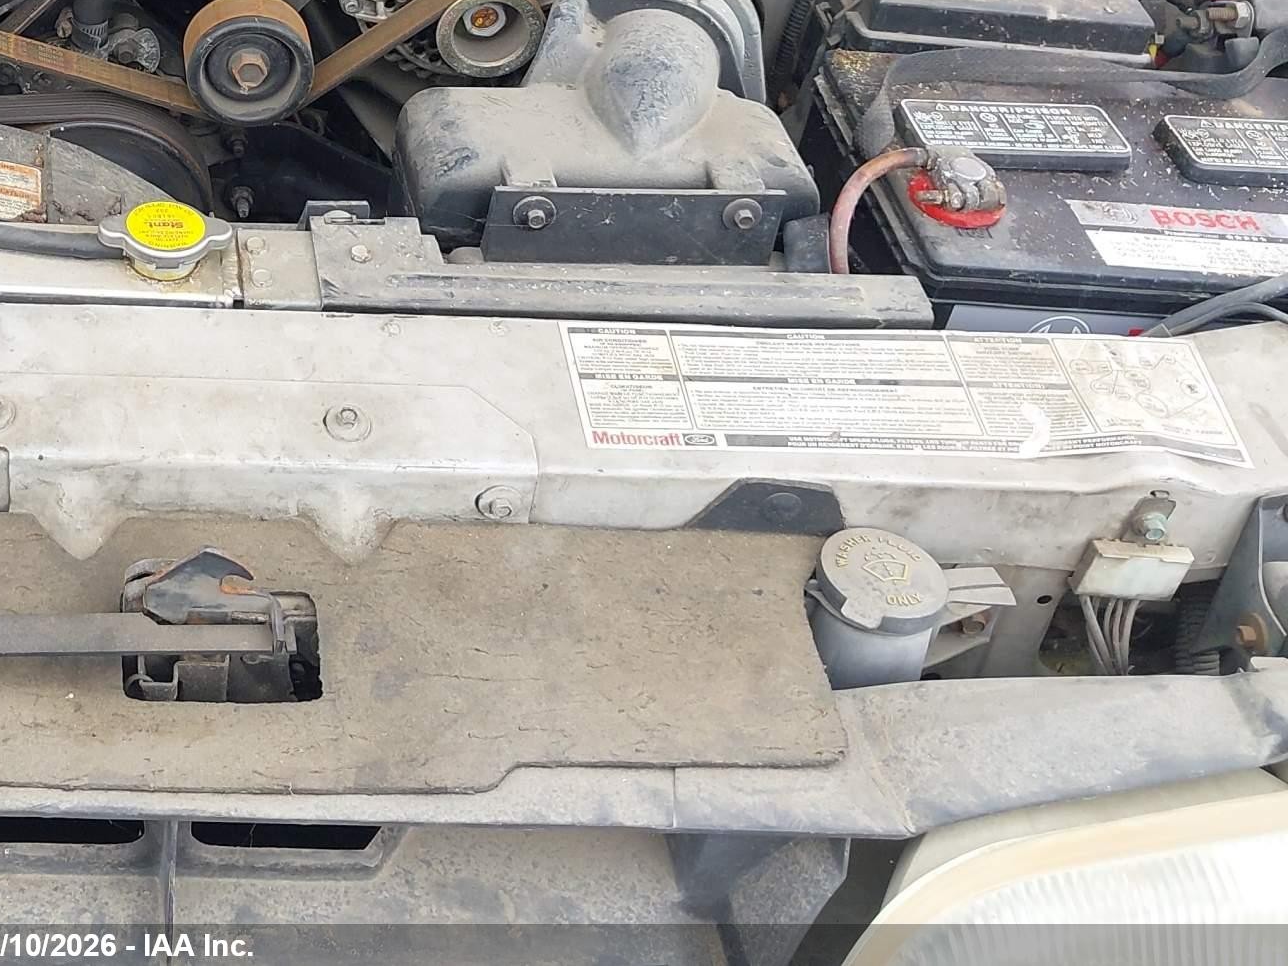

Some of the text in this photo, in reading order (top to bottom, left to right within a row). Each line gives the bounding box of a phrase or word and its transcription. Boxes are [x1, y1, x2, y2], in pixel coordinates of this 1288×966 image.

[148, 221, 184, 229] Stant
[1149, 208, 1261, 232] BOSCH
[592, 430, 683, 446] Motorcraft
[835, 535, 872, 568] WASHER
[885, 592, 923, 607] ONLY
